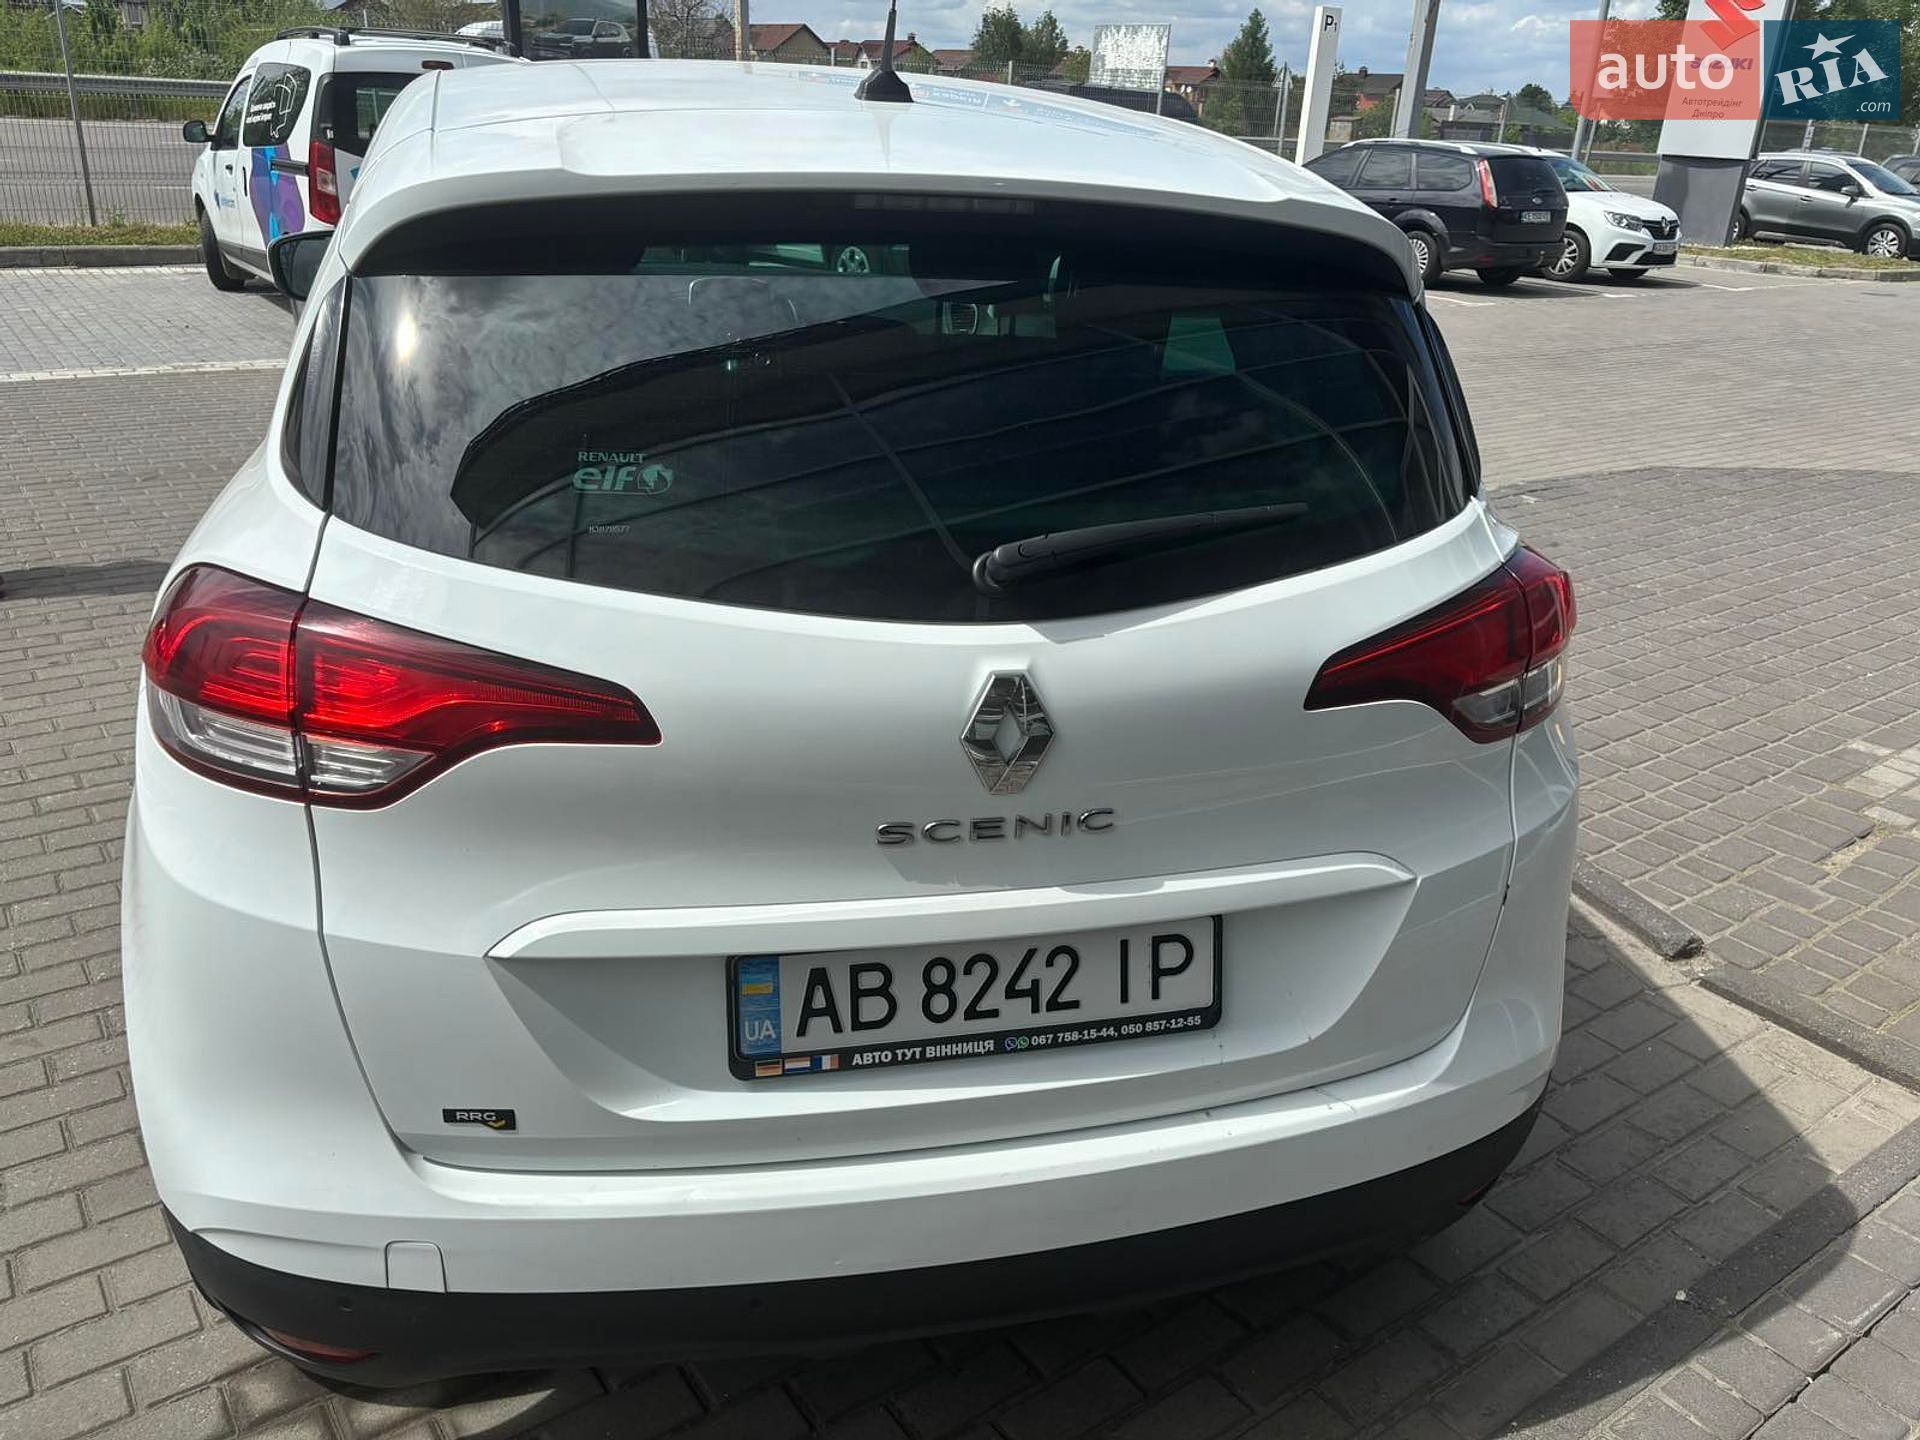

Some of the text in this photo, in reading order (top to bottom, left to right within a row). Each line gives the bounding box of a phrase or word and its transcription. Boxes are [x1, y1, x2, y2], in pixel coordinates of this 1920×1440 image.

[578, 451, 647, 463] RENAULT
[573, 465, 637, 491] elf
[876, 807, 1114, 845] SCENIC
[796, 933, 1194, 1037] AB 8242 IP
[745, 1019, 777, 1041] UA
[852, 1051, 893, 1066] АВТО
[896, 1047, 923, 1061] ТУТ
[925, 1039, 995, 1058] ВІННИЦЯ
[1031, 1034, 1054, 1046] 067
[1121, 1023, 1143, 1035] 050
[1145, 1015, 1201, 1031] 857-12-55
[456, 1112, 496, 1121] RRG
